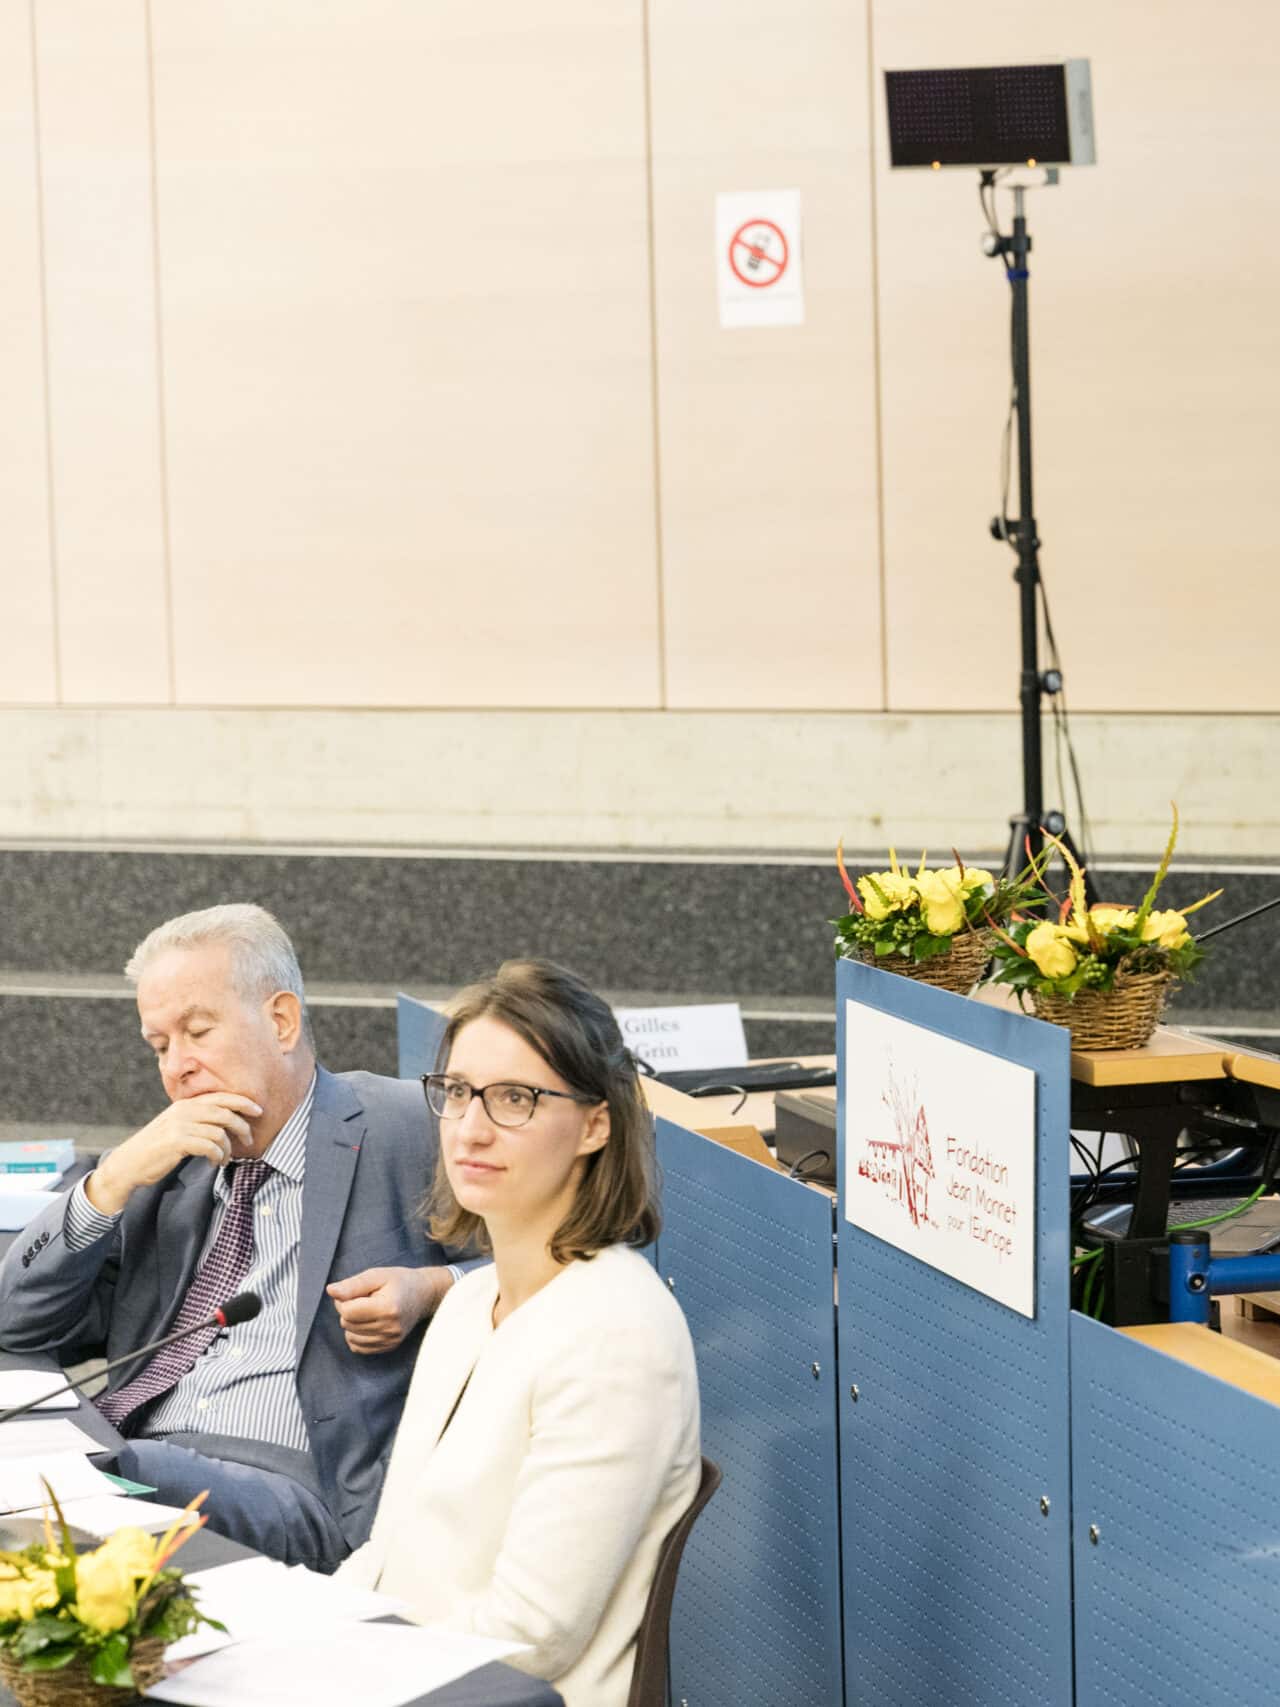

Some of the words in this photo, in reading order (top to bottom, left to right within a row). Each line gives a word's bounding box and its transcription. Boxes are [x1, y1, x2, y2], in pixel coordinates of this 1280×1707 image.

[624, 1017, 680, 1034] Gilles
[946, 1135, 1009, 1189] Fondation
[946, 1174, 972, 1206] Jean
[976, 1184, 1017, 1226] Monnet
